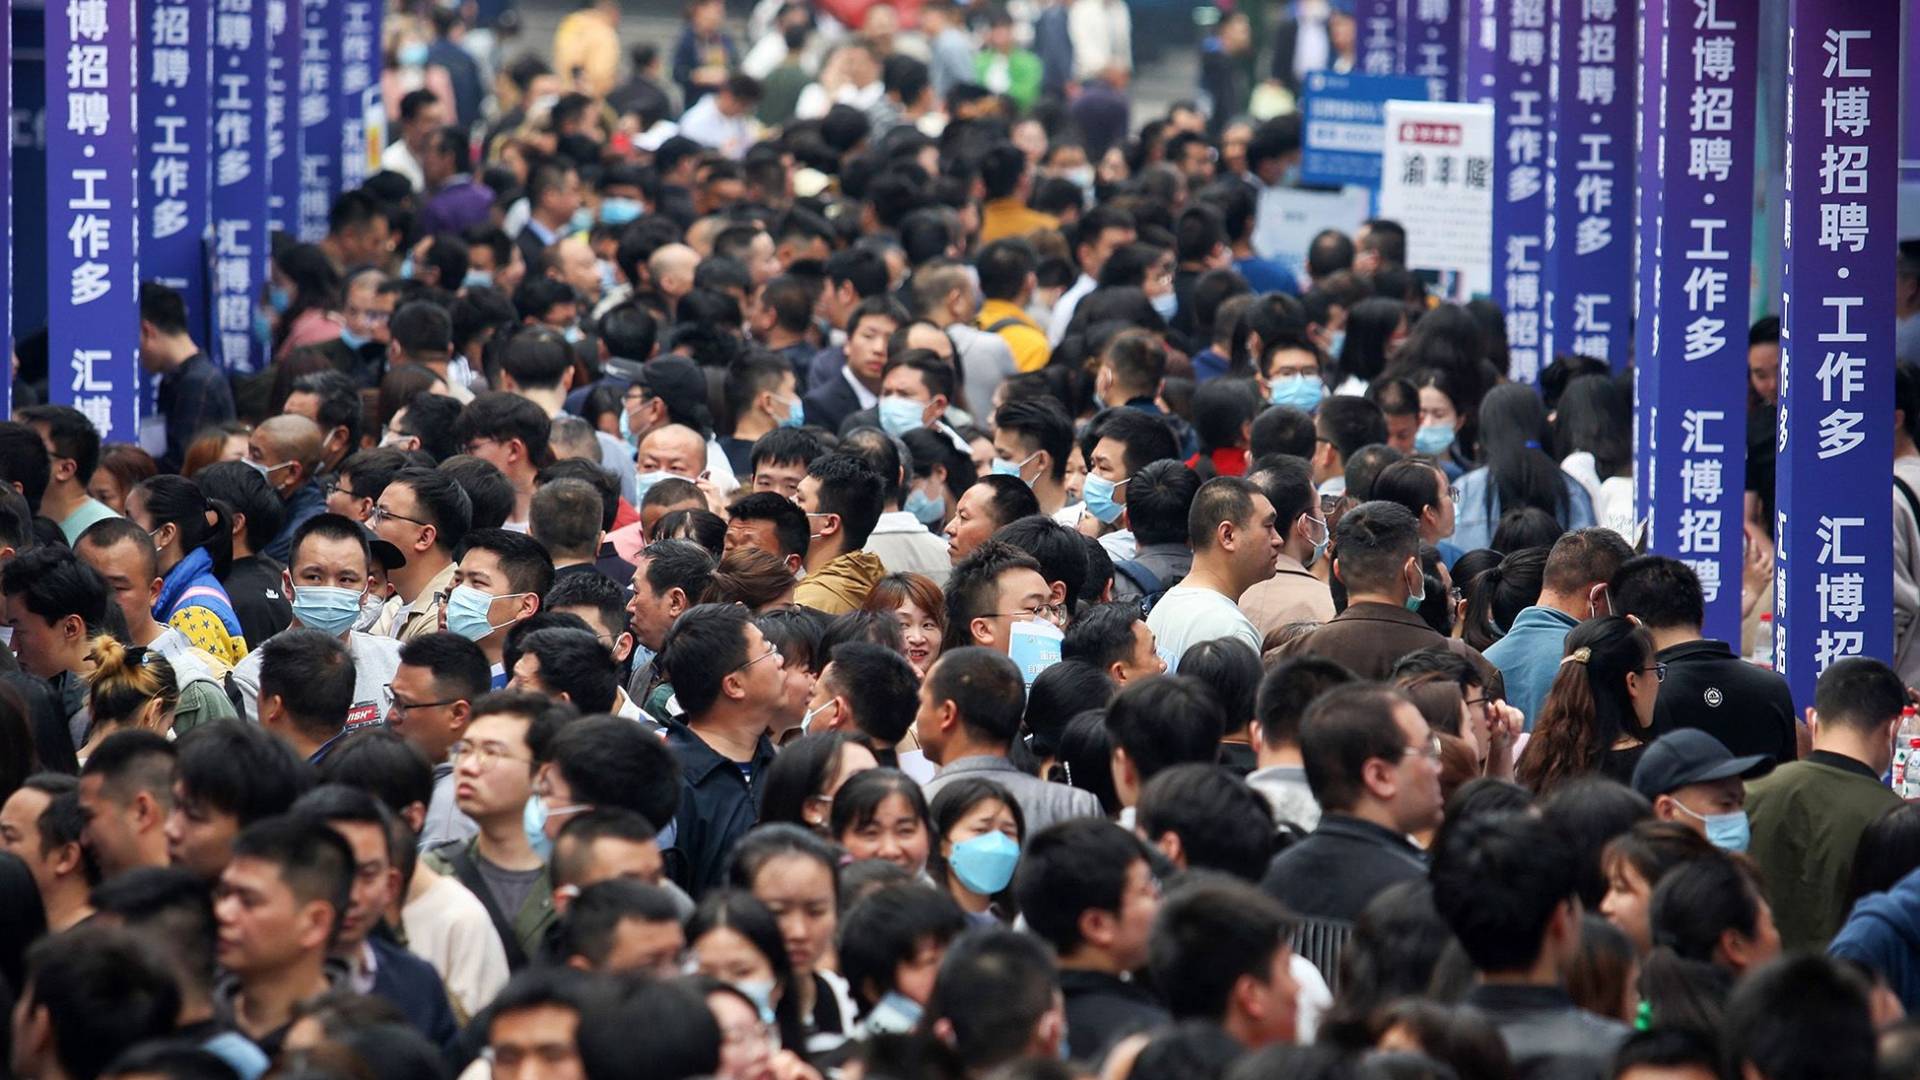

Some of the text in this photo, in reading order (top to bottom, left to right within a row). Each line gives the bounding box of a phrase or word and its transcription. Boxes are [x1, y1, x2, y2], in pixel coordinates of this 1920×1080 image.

[150, 0, 190, 239] 招聘·工作多
[1815, 28, 1872, 460] 汇博招聘·工作多
